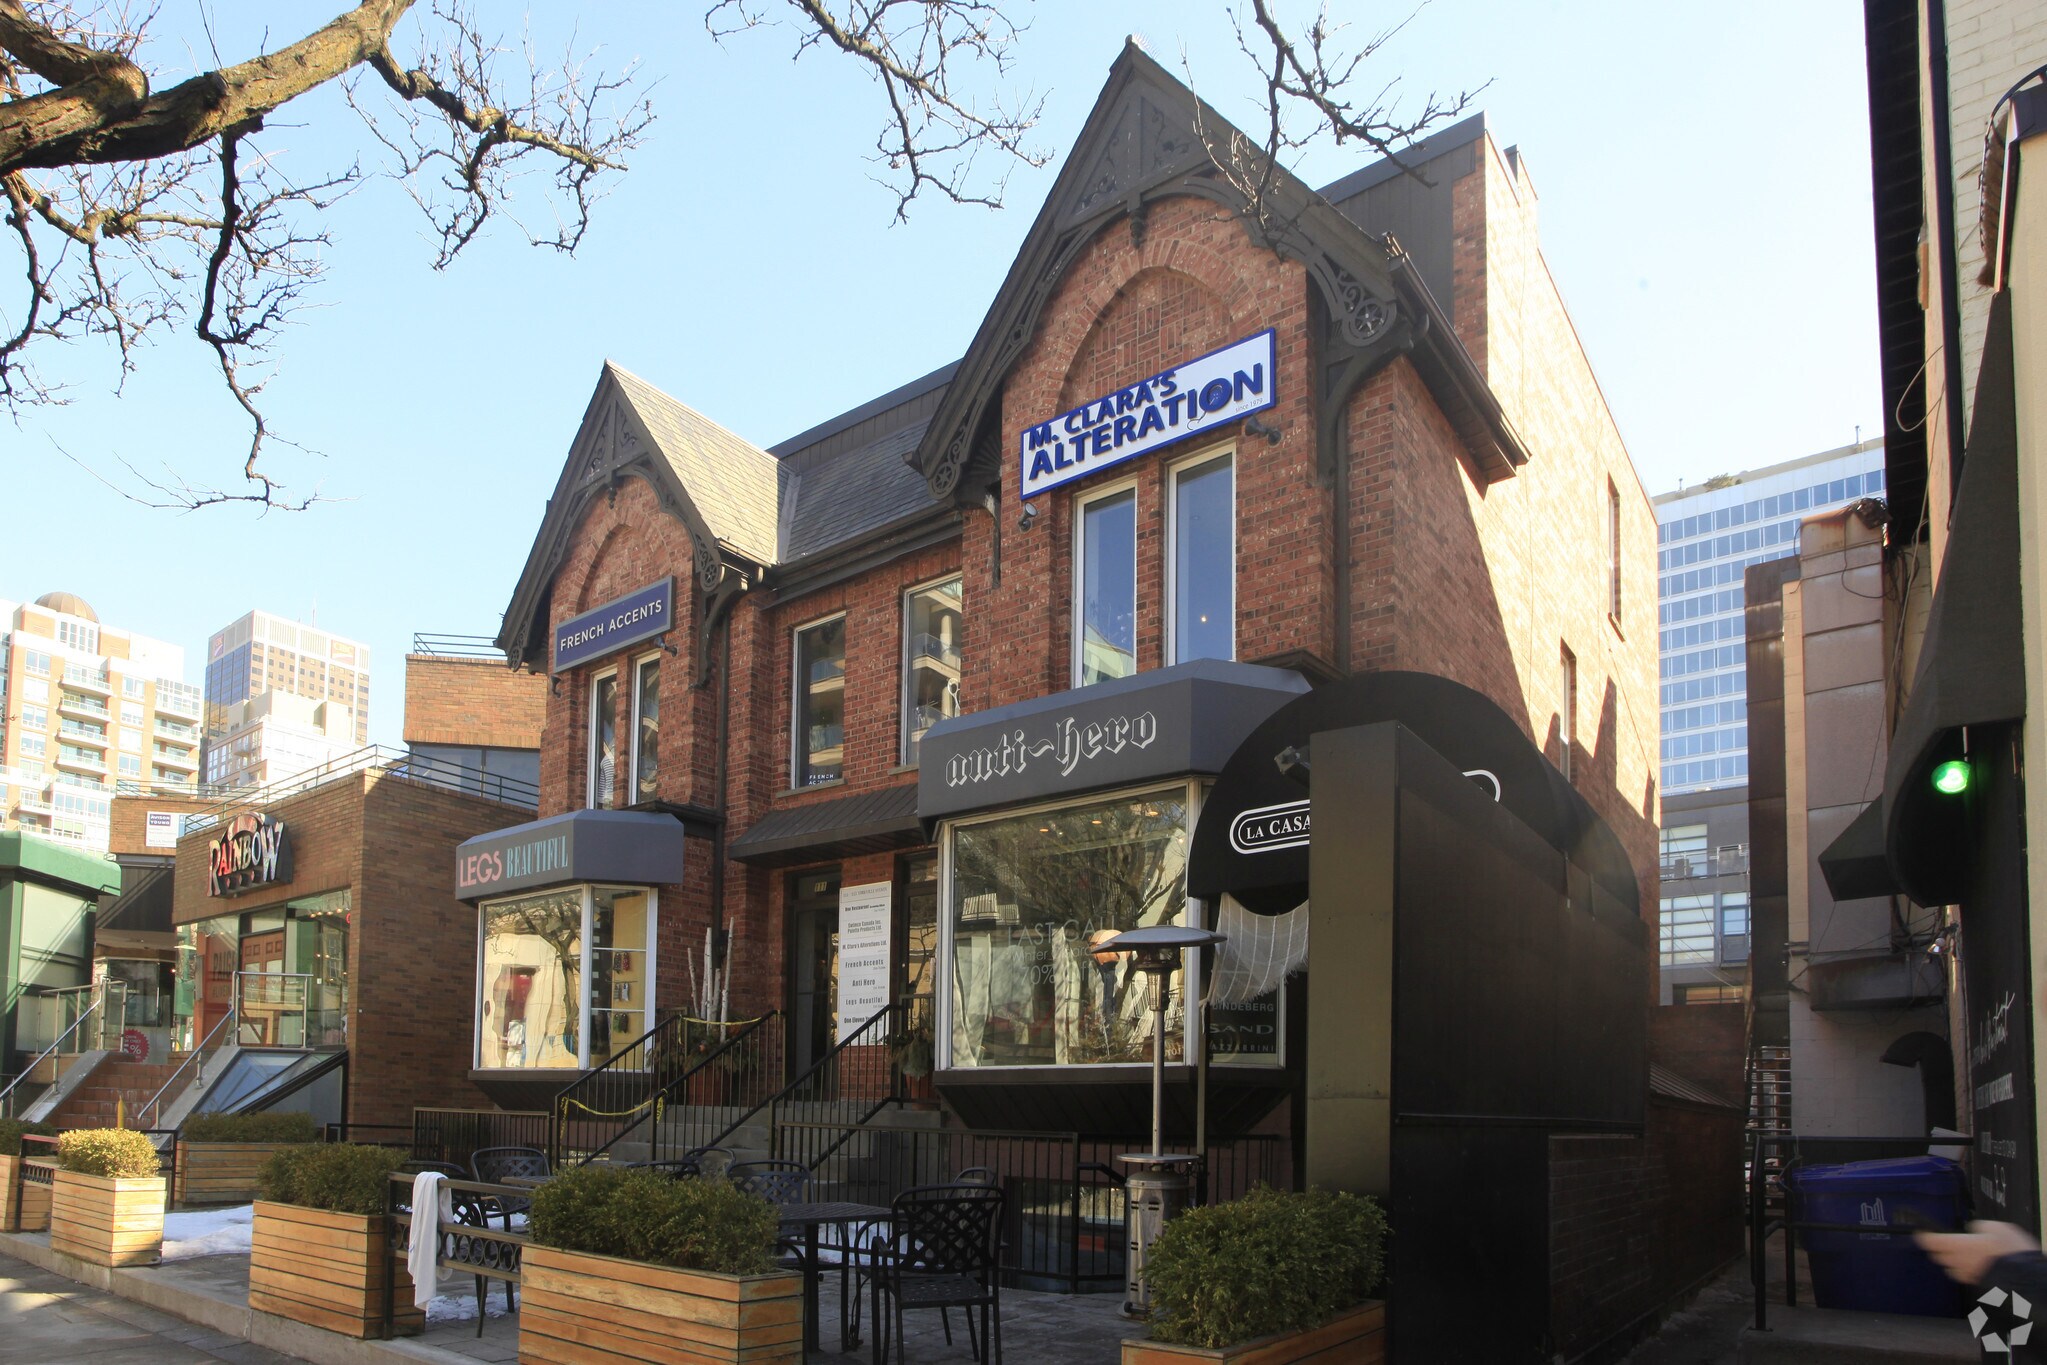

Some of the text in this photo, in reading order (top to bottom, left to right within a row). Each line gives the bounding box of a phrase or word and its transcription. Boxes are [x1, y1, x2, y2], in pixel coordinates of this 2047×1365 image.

[1028, 371, 1178, 450] M. CLARA'S
[1028, 362, 1264, 481] ALTERATION
[560, 599, 662, 652] FRENCH ACCENTS
[1246, 814, 1311, 840] LA CASA
[207, 820, 284, 897] RAINBOW
[460, 835, 568, 888] LEGS BEAUTIFUL
[1008, 921, 1055, 947] LAST
[845, 959, 884, 968] French Accents
[1020, 963, 1056, 985] 70%
[852, 978, 875, 987] Anti Hero
[845, 996, 883, 1006] Legs Beautiful
[1209, 1023, 1274, 1035] SAND
